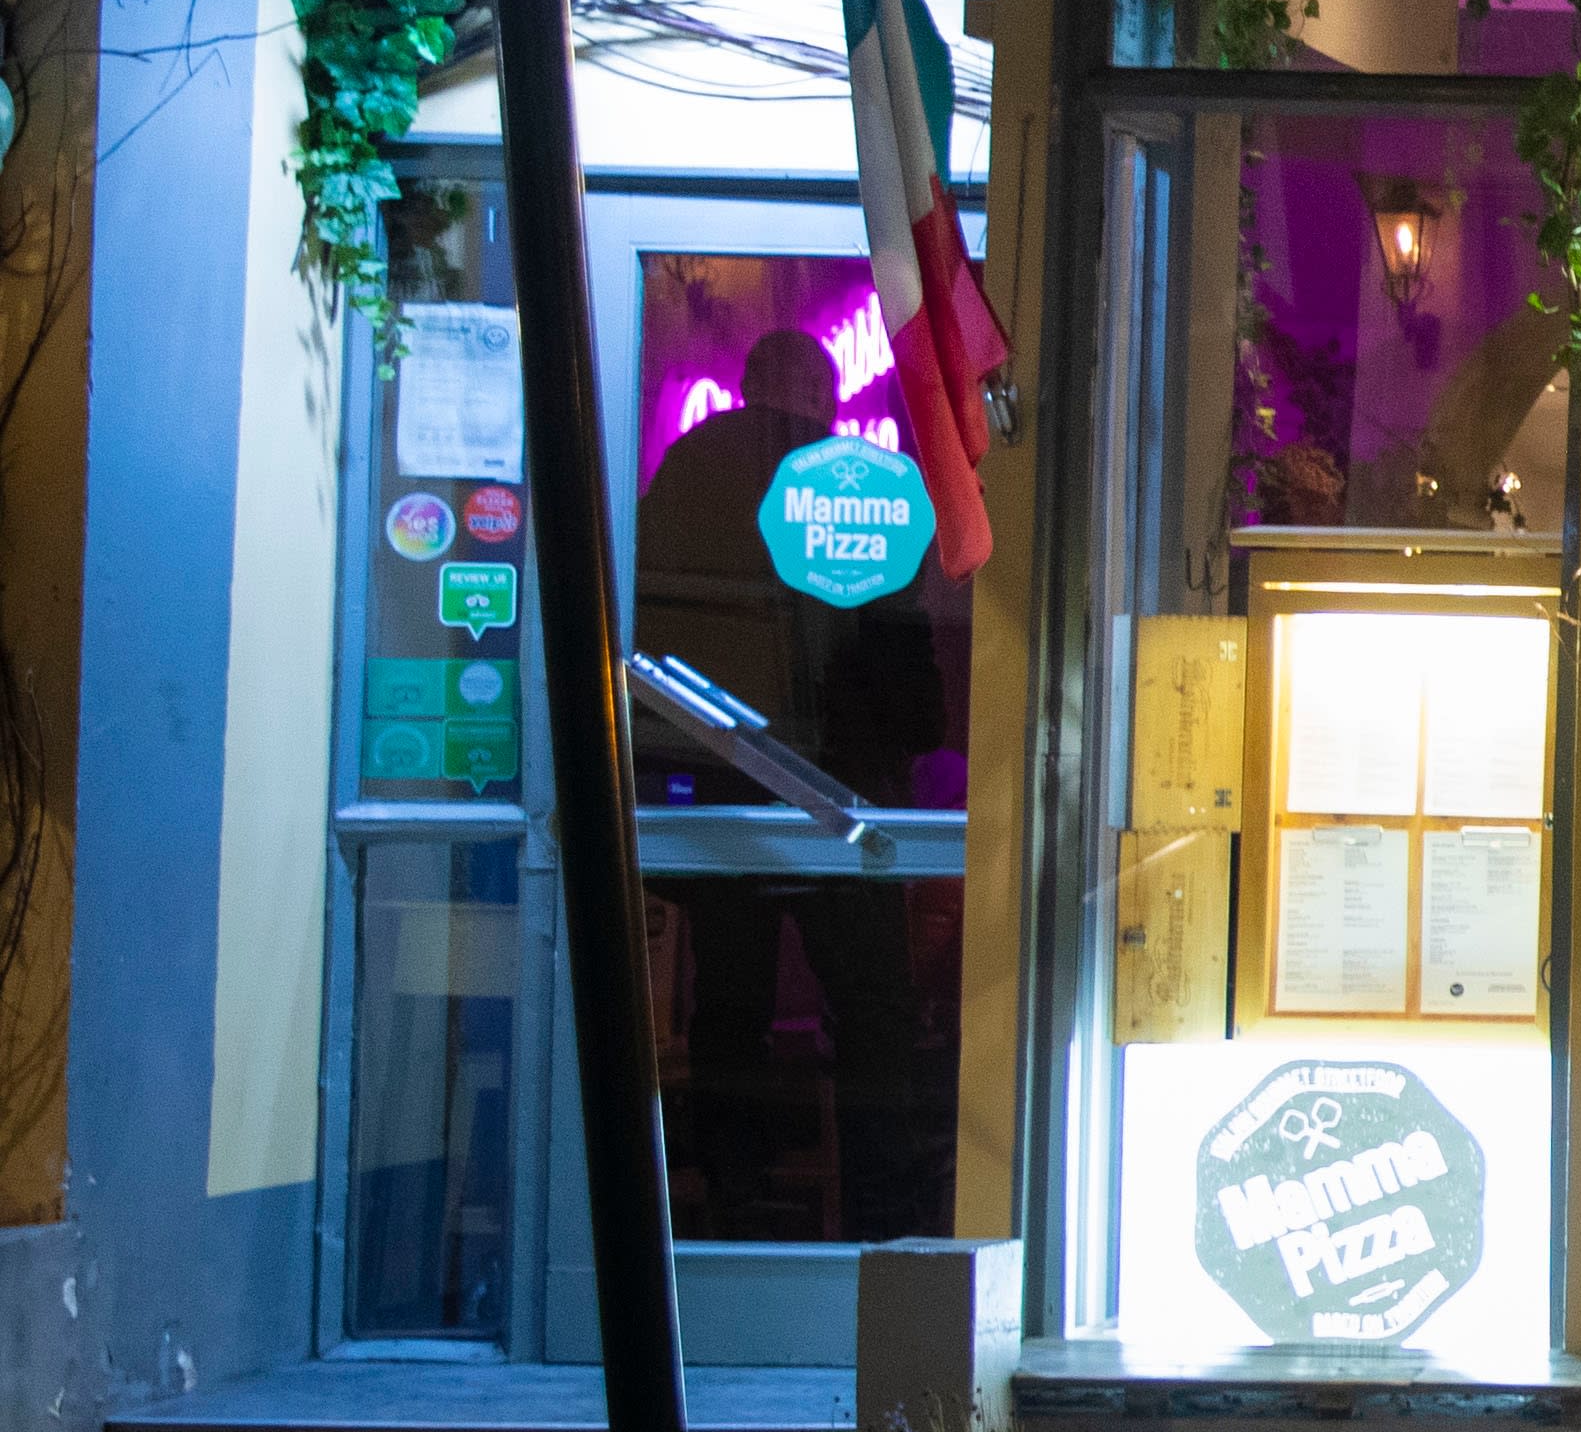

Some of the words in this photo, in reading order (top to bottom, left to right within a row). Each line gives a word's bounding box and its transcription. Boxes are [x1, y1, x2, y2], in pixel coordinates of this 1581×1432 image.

[784, 486, 911, 527] Mamma
[805, 523, 889, 562] Pizza
[1216, 1129, 1449, 1251] Mamma
[1275, 1204, 1437, 1299] Pizza
